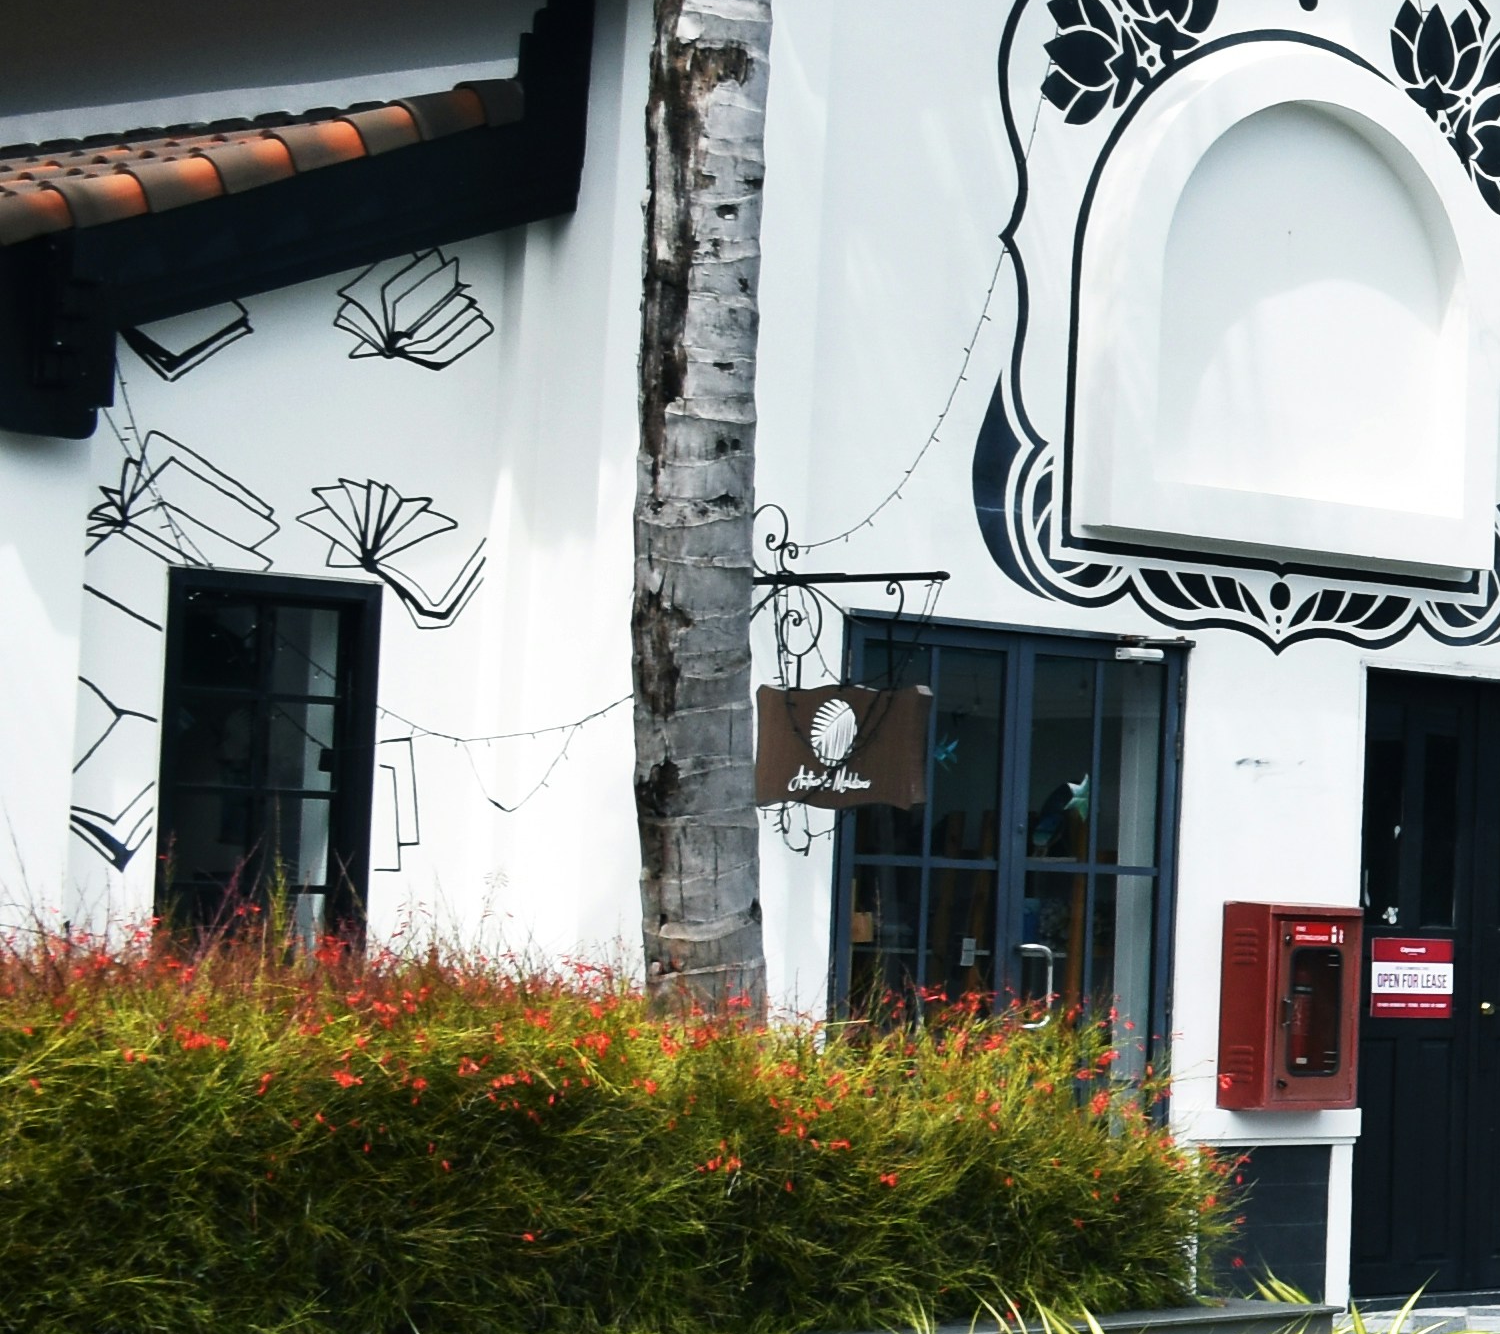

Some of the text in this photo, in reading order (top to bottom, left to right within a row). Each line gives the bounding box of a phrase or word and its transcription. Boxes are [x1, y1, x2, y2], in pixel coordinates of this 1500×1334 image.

[1377, 973, 1447, 989] OPEN FOR LEASE
